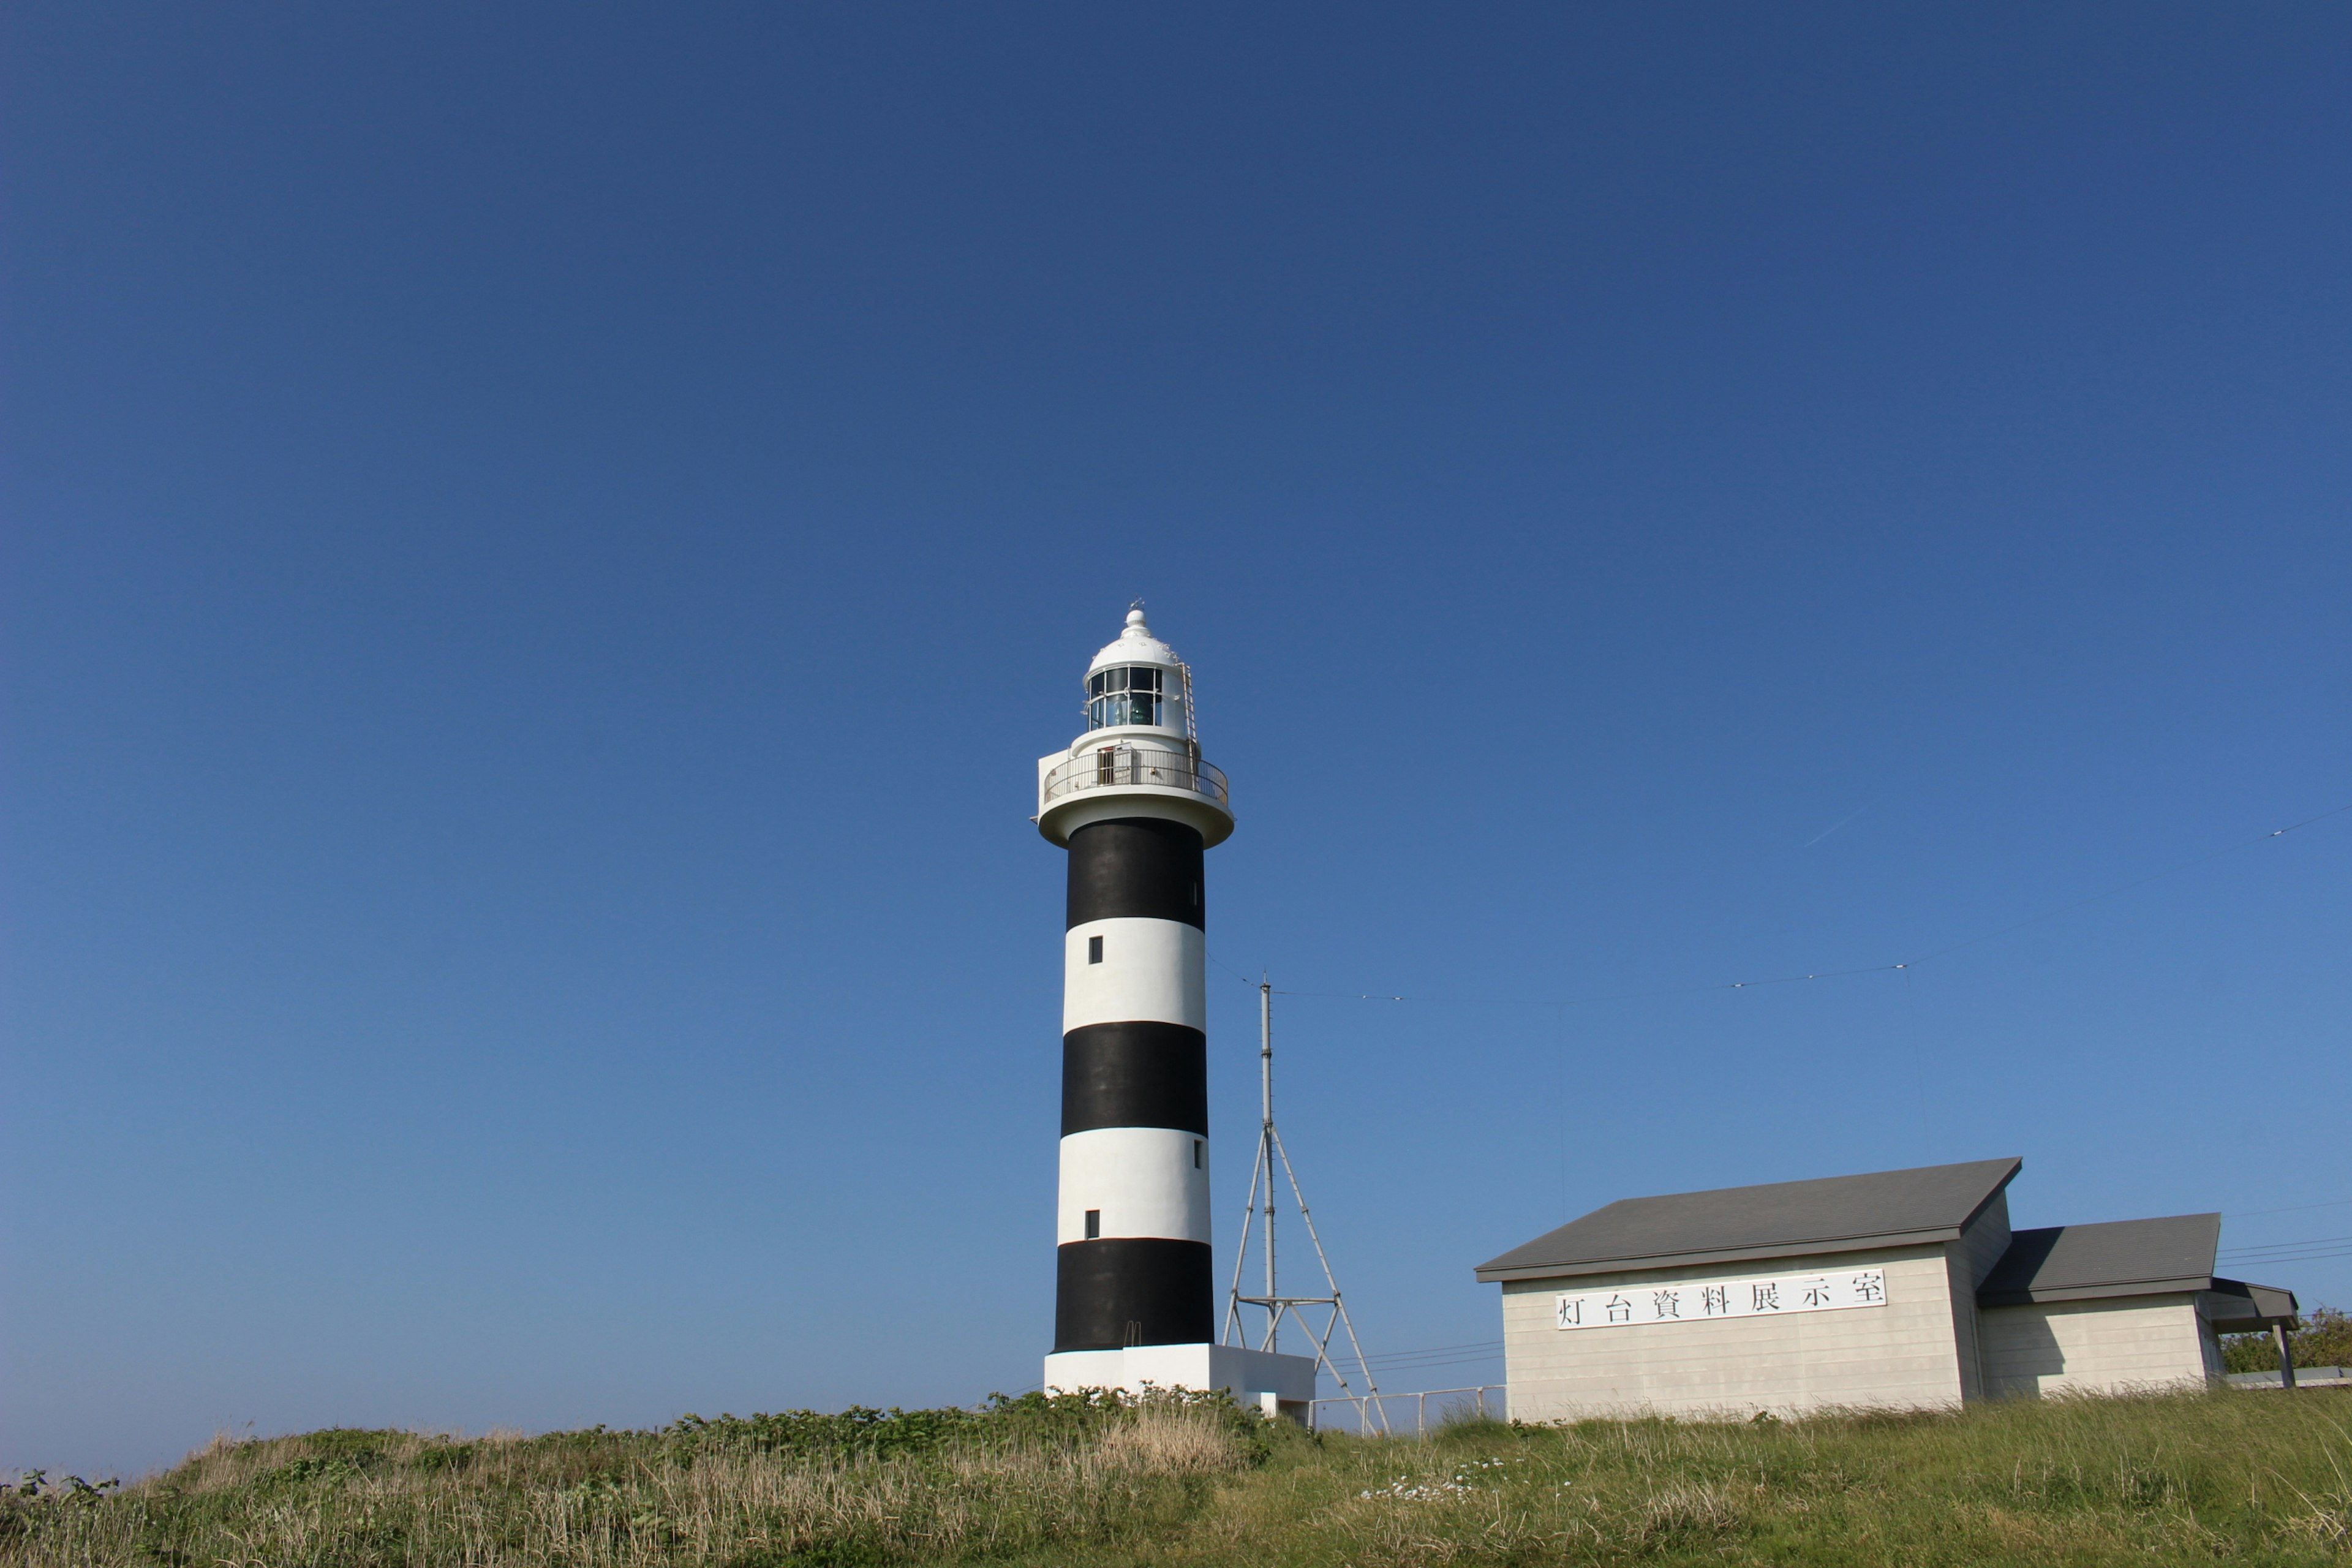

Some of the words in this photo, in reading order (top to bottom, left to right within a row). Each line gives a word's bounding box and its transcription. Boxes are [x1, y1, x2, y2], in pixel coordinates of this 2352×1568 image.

[1559, 1273, 1884, 1325] 灯台資料展示室
